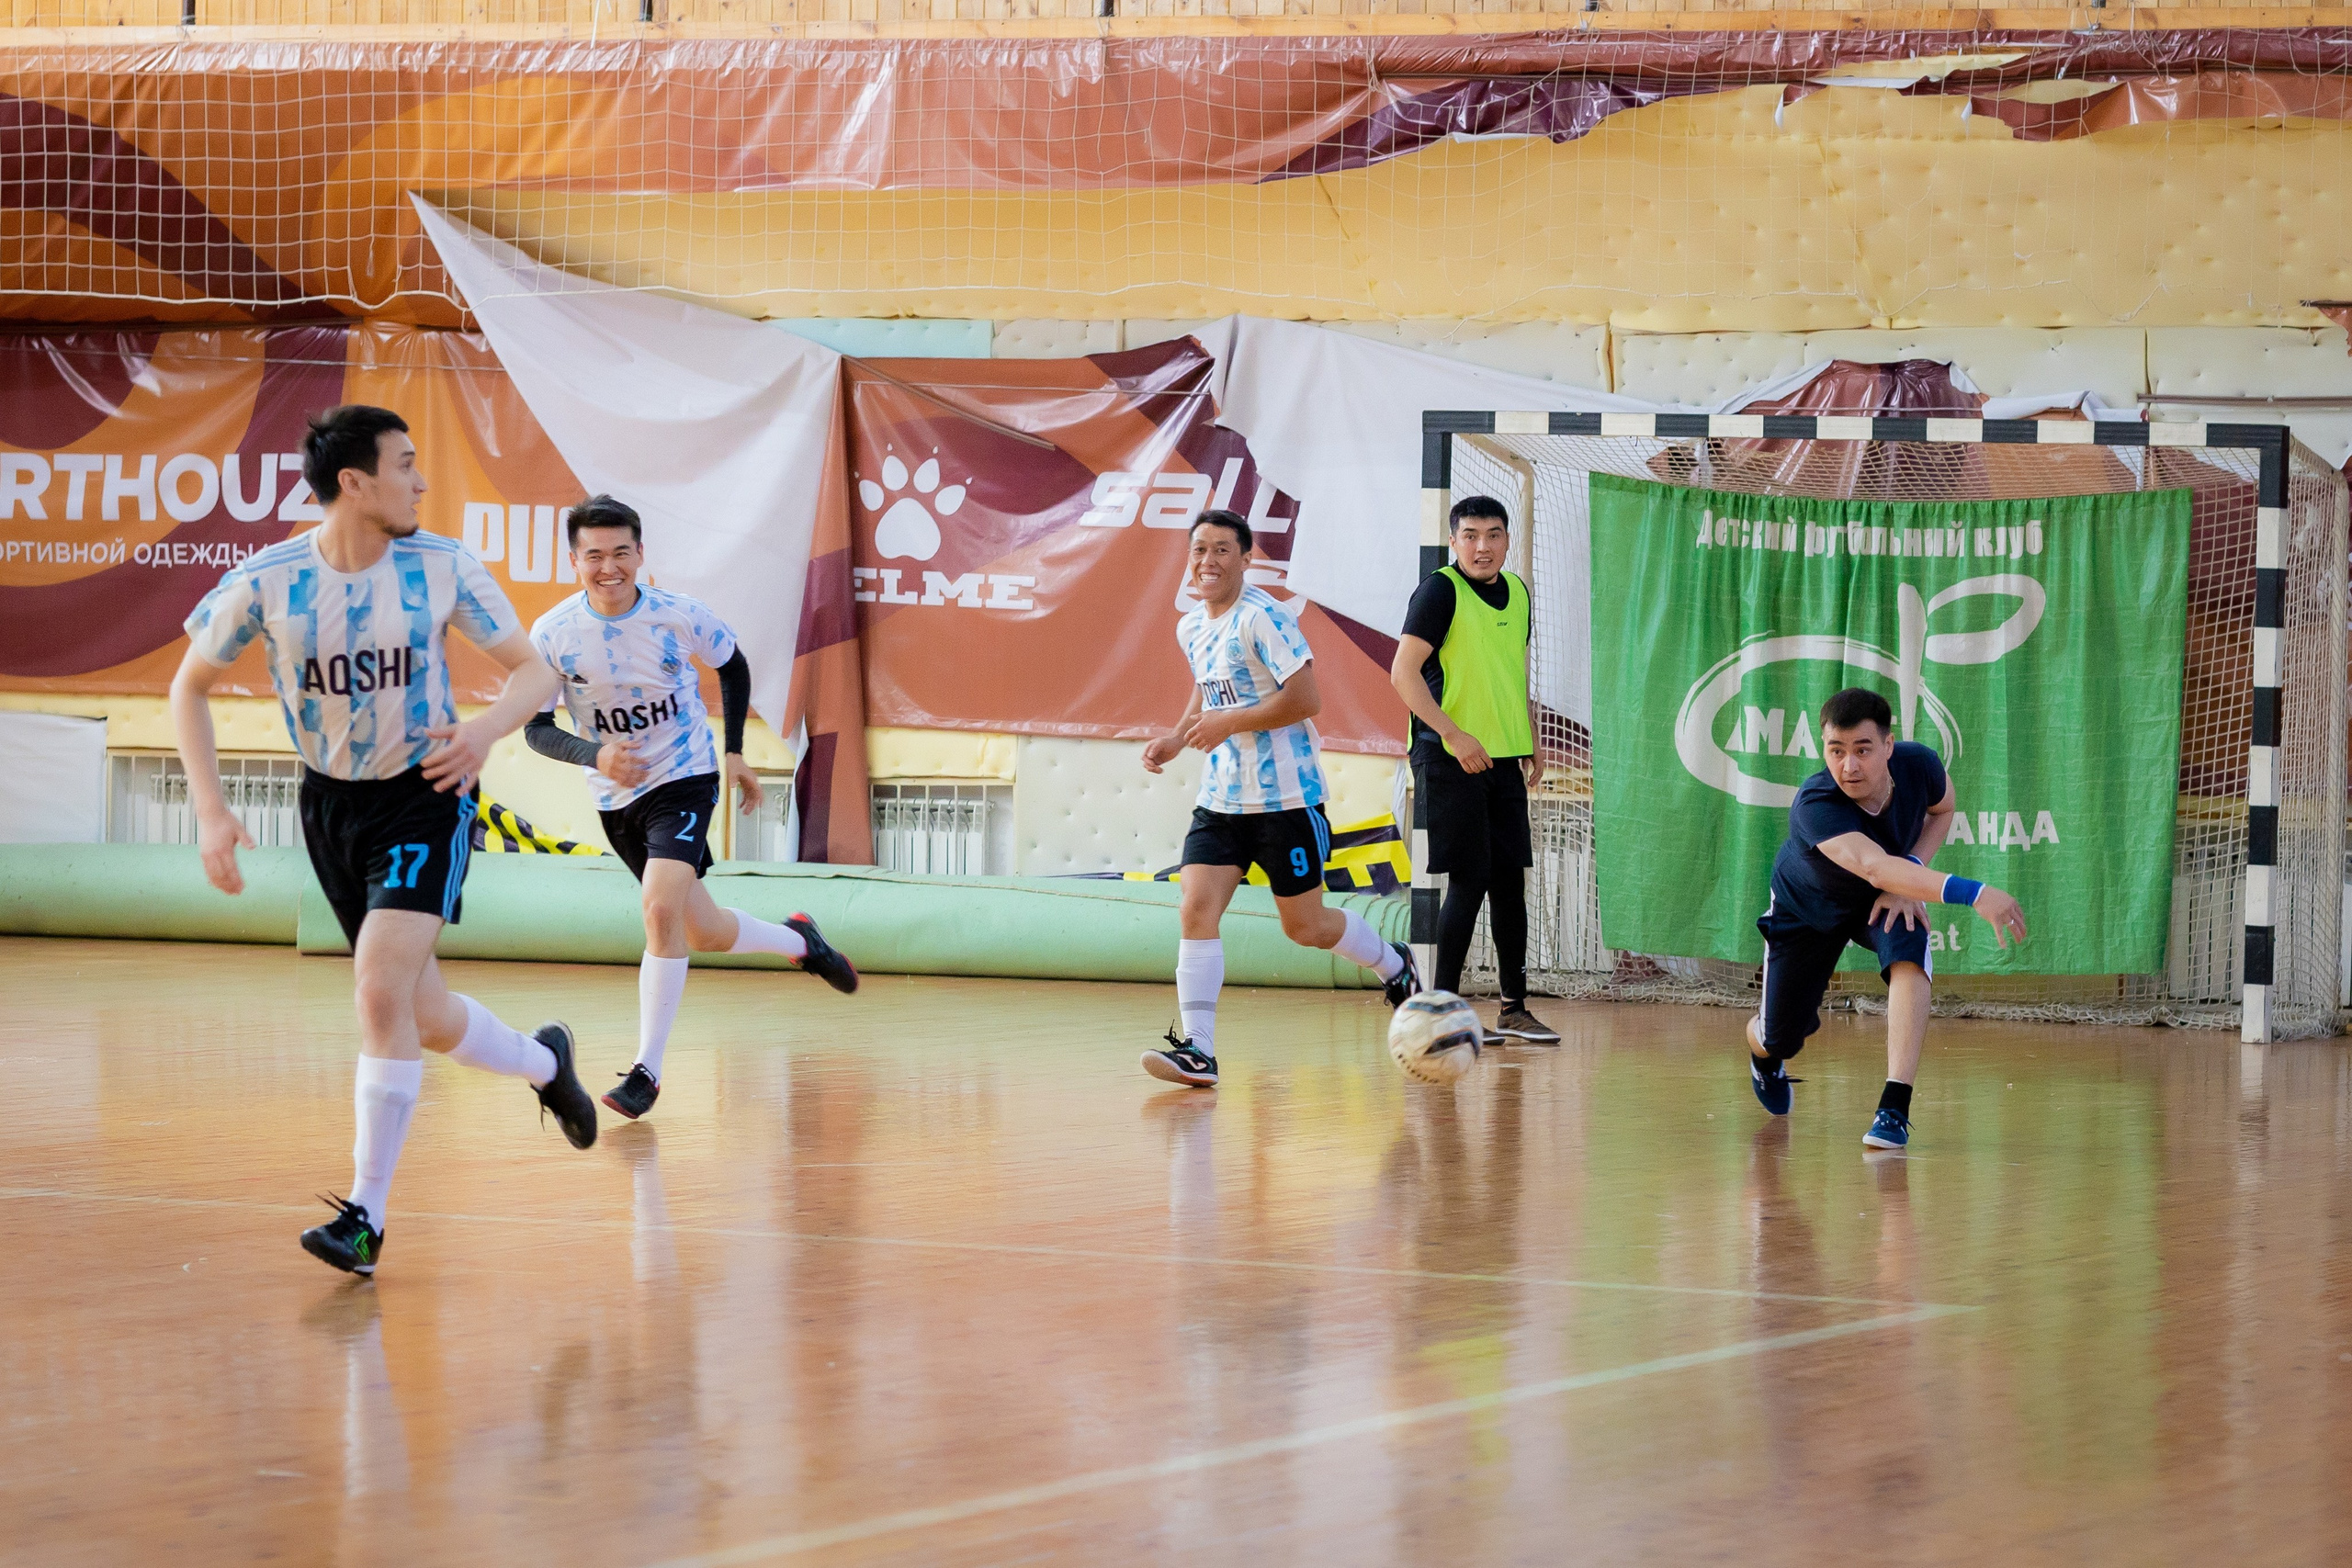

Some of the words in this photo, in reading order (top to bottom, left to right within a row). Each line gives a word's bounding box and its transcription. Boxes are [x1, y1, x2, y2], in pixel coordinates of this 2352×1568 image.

[0, 537, 126, 564] РТИВНОЙ
[133, 541, 254, 569] ОДЕЖДЫ
[1974, 520, 2044, 559] клуб
[304, 646, 413, 696] AQSHI
[594, 693, 678, 734] AQSHI
[674, 811, 697, 842] 2
[384, 843, 429, 888] 17
[1289, 847, 1310, 877] 9
